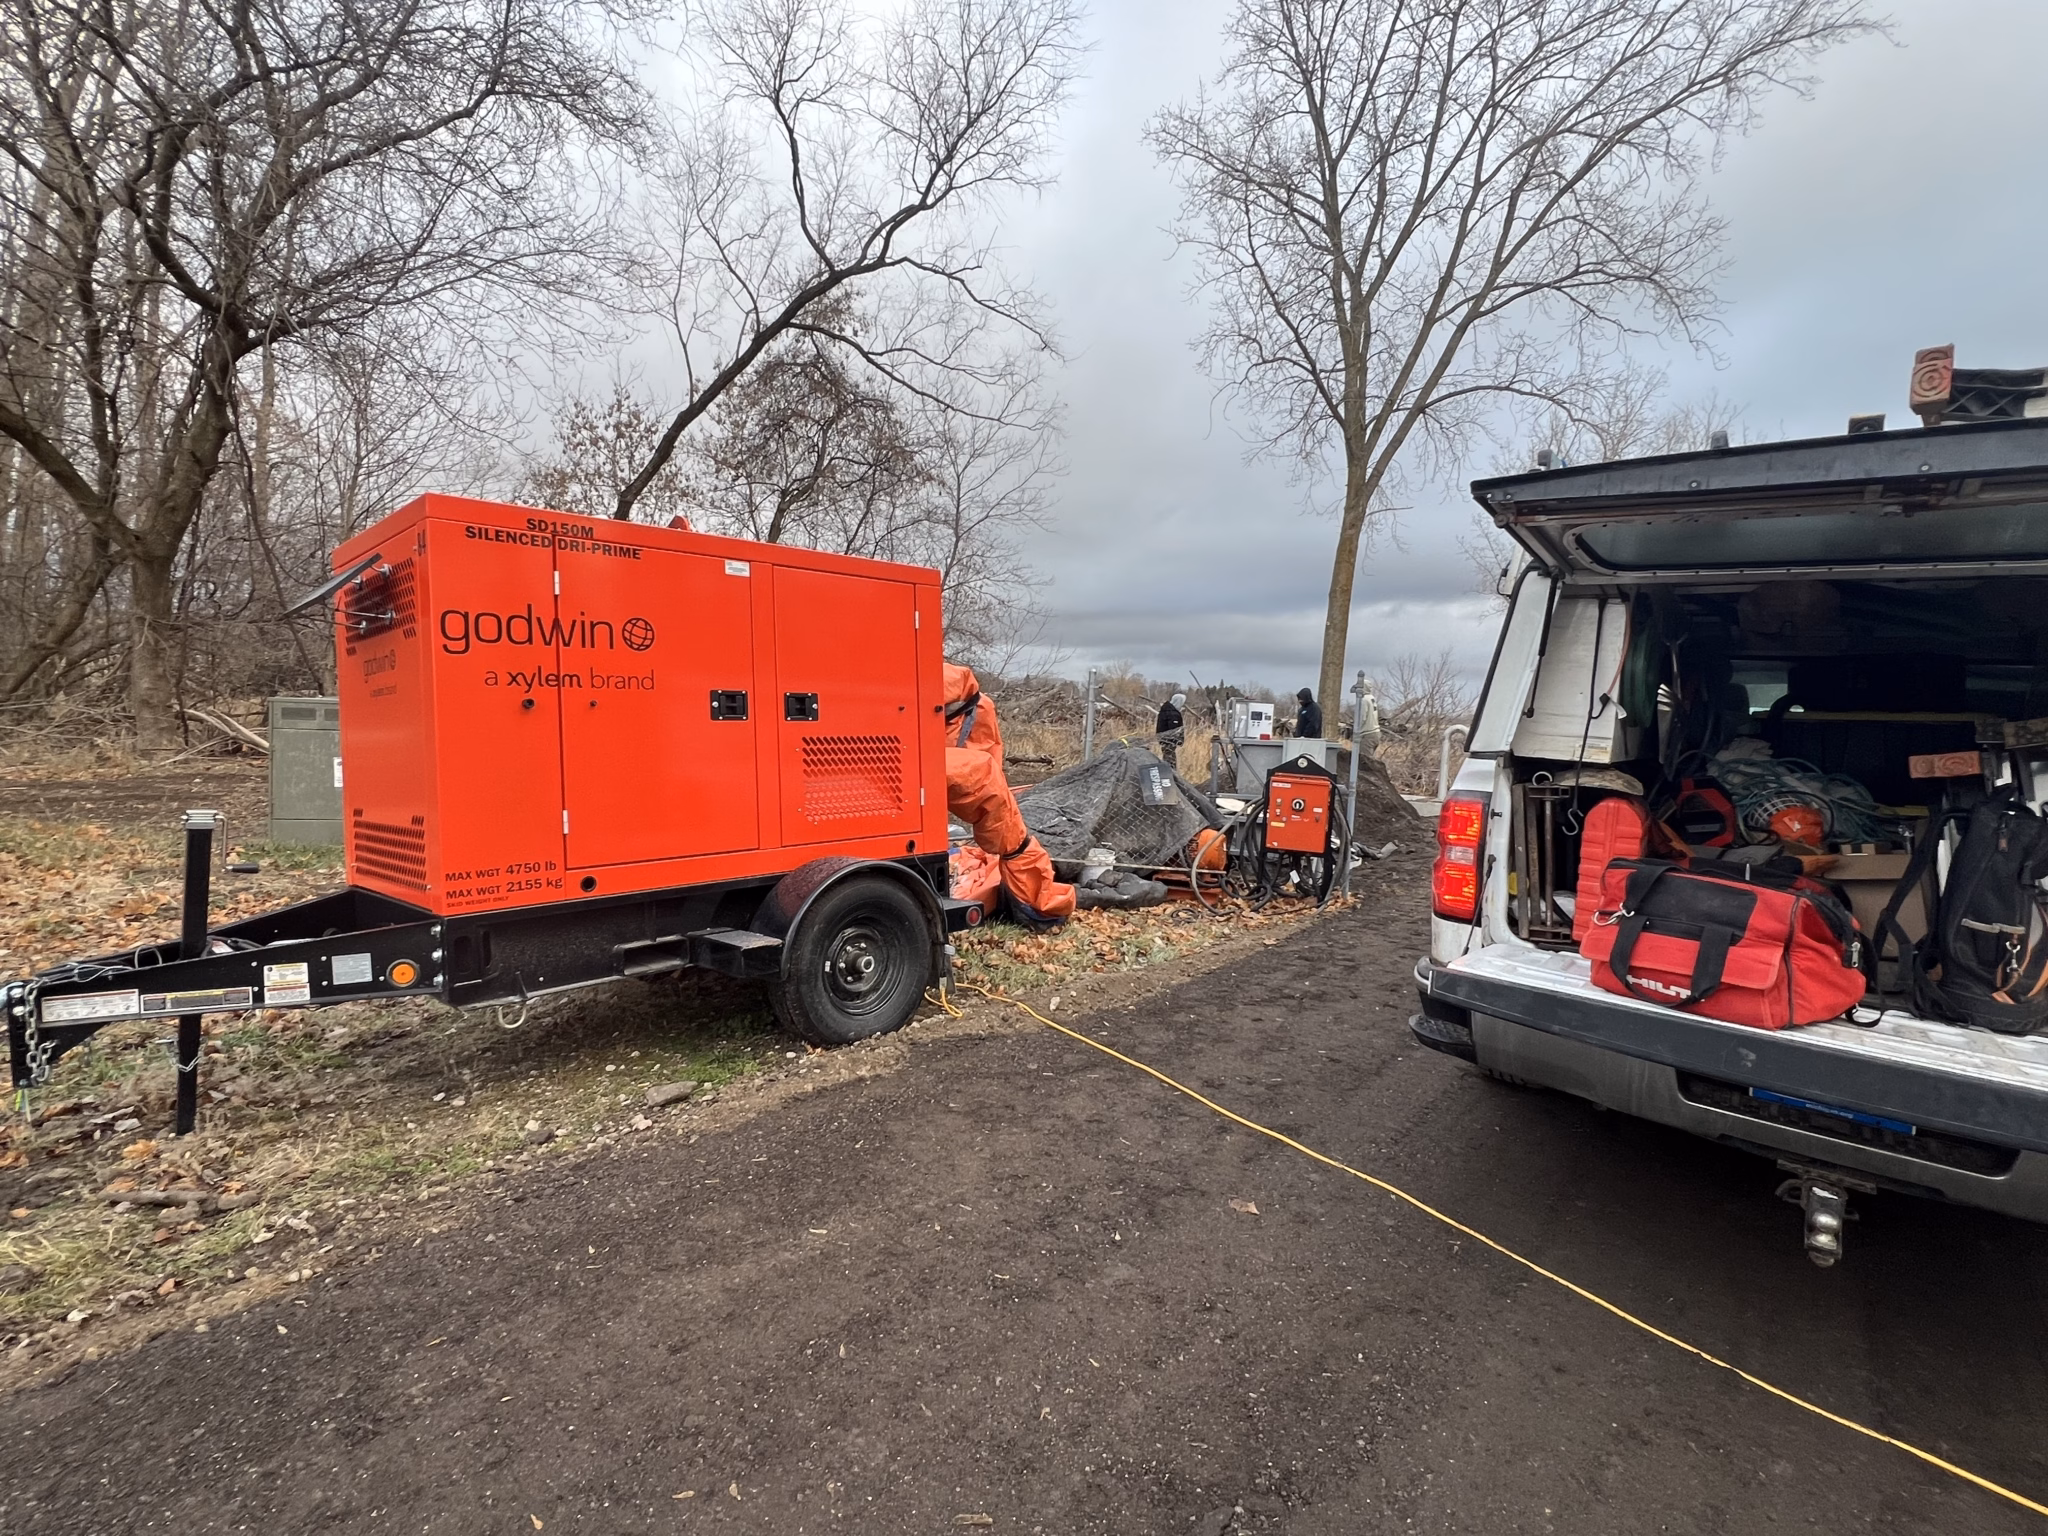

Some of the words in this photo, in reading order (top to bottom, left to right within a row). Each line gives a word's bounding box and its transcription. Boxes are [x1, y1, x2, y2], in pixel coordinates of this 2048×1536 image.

[526, 517, 594, 539] SD150M
[465, 525, 553, 549] SILENCED
[557, 537, 642, 560] DRI-PRIME
[440, 603, 614, 655] godwin
[484, 670, 499, 687] a
[506, 665, 583, 694] xylem
[590, 667, 655, 690] brand
[445, 871, 473, 882] MAX
[475, 868, 501, 879] WGT
[505, 861, 541, 875] 4750
[545, 860, 557, 872] lb
[446, 888, 473, 899] MAX
[476, 885, 502, 896] WGT
[506, 878, 543, 892] 2155
[546, 877, 563, 889] kg
[465, 898, 491, 906] WEIGHT
[1626, 974, 1705, 1002] HILT
